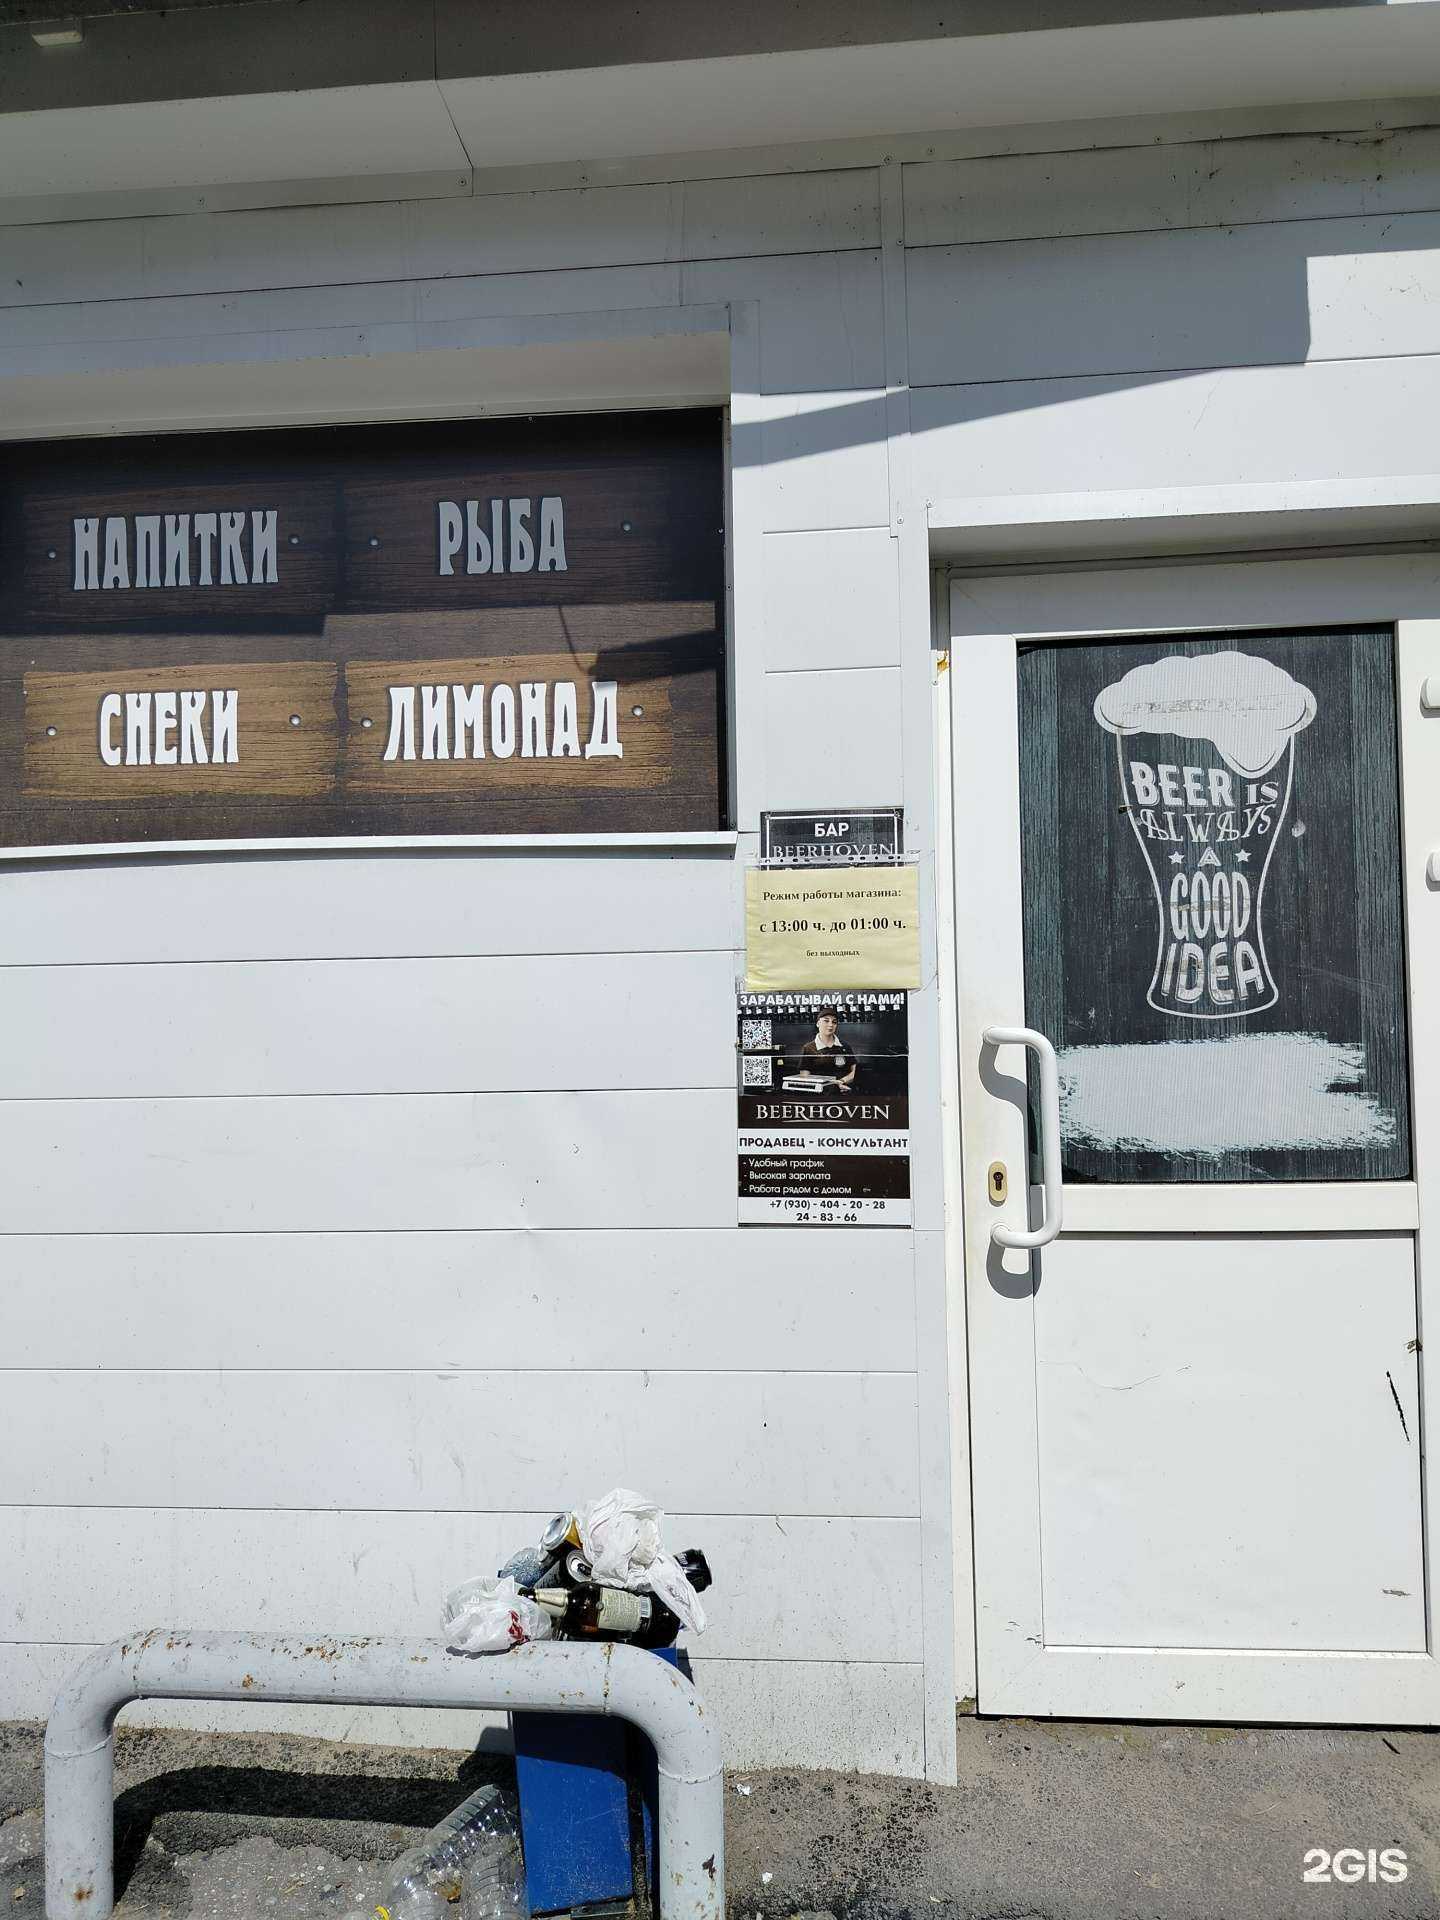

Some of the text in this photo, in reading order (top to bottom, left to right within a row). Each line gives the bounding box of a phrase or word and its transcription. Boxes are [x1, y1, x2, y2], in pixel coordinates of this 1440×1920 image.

[438, 496, 568, 576] РЫБА
[73, 510, 279, 591] НАПИТКИ
[100, 689, 240, 767] СНЕКИ
[384, 680, 623, 761] ЛИМОНАД
[1129, 761, 1279, 808] BEER IS
[814, 822, 850, 838] БАР
[1138, 804, 1277, 843] ALWAYS
[771, 843, 895, 858] BEERHOVEN
[1197, 846, 1222, 867] A
[763, 889, 902, 902] Режим работы магазина:
[1170, 871, 1251, 941] GOOD
[760, 917, 907, 933] с 13:00 ч. до 01:00 ч.
[806, 948, 860, 958] без выходных
[1161, 941, 1265, 1005] IDEA
[740, 992, 905, 1006] ЗАРАБАТЫВАЙ С НАМИ!
[756, 1104, 890, 1120] BEERHOVEN
[739, 1137, 805, 1149] ПРОДАВЕЦ
[817, 1138, 908, 1148] КОНСУЛЬТАНТ
[749, 1158, 788, 1168] Удобный
[789, 1158, 825, 1169] график
[749, 1172, 787, 1180] Высокая
[789, 1172, 831, 1182] зарплата
[749, 1185, 781, 1194] Работа
[783, 1187, 811, 1195] рядом
[821, 1187, 852, 1195] домом
[769, 1200, 782, 1209] +7
[784, 1200, 811, 1210] (930)
[820, 1201, 840, 1209] 404
[850, 1201, 863, 1209] 20
[873, 1201, 886, 1209] 28
[796, 1213, 810, 1221] 24
[820, 1213, 833, 1222] 83
[844, 1213, 858, 1222] 66
